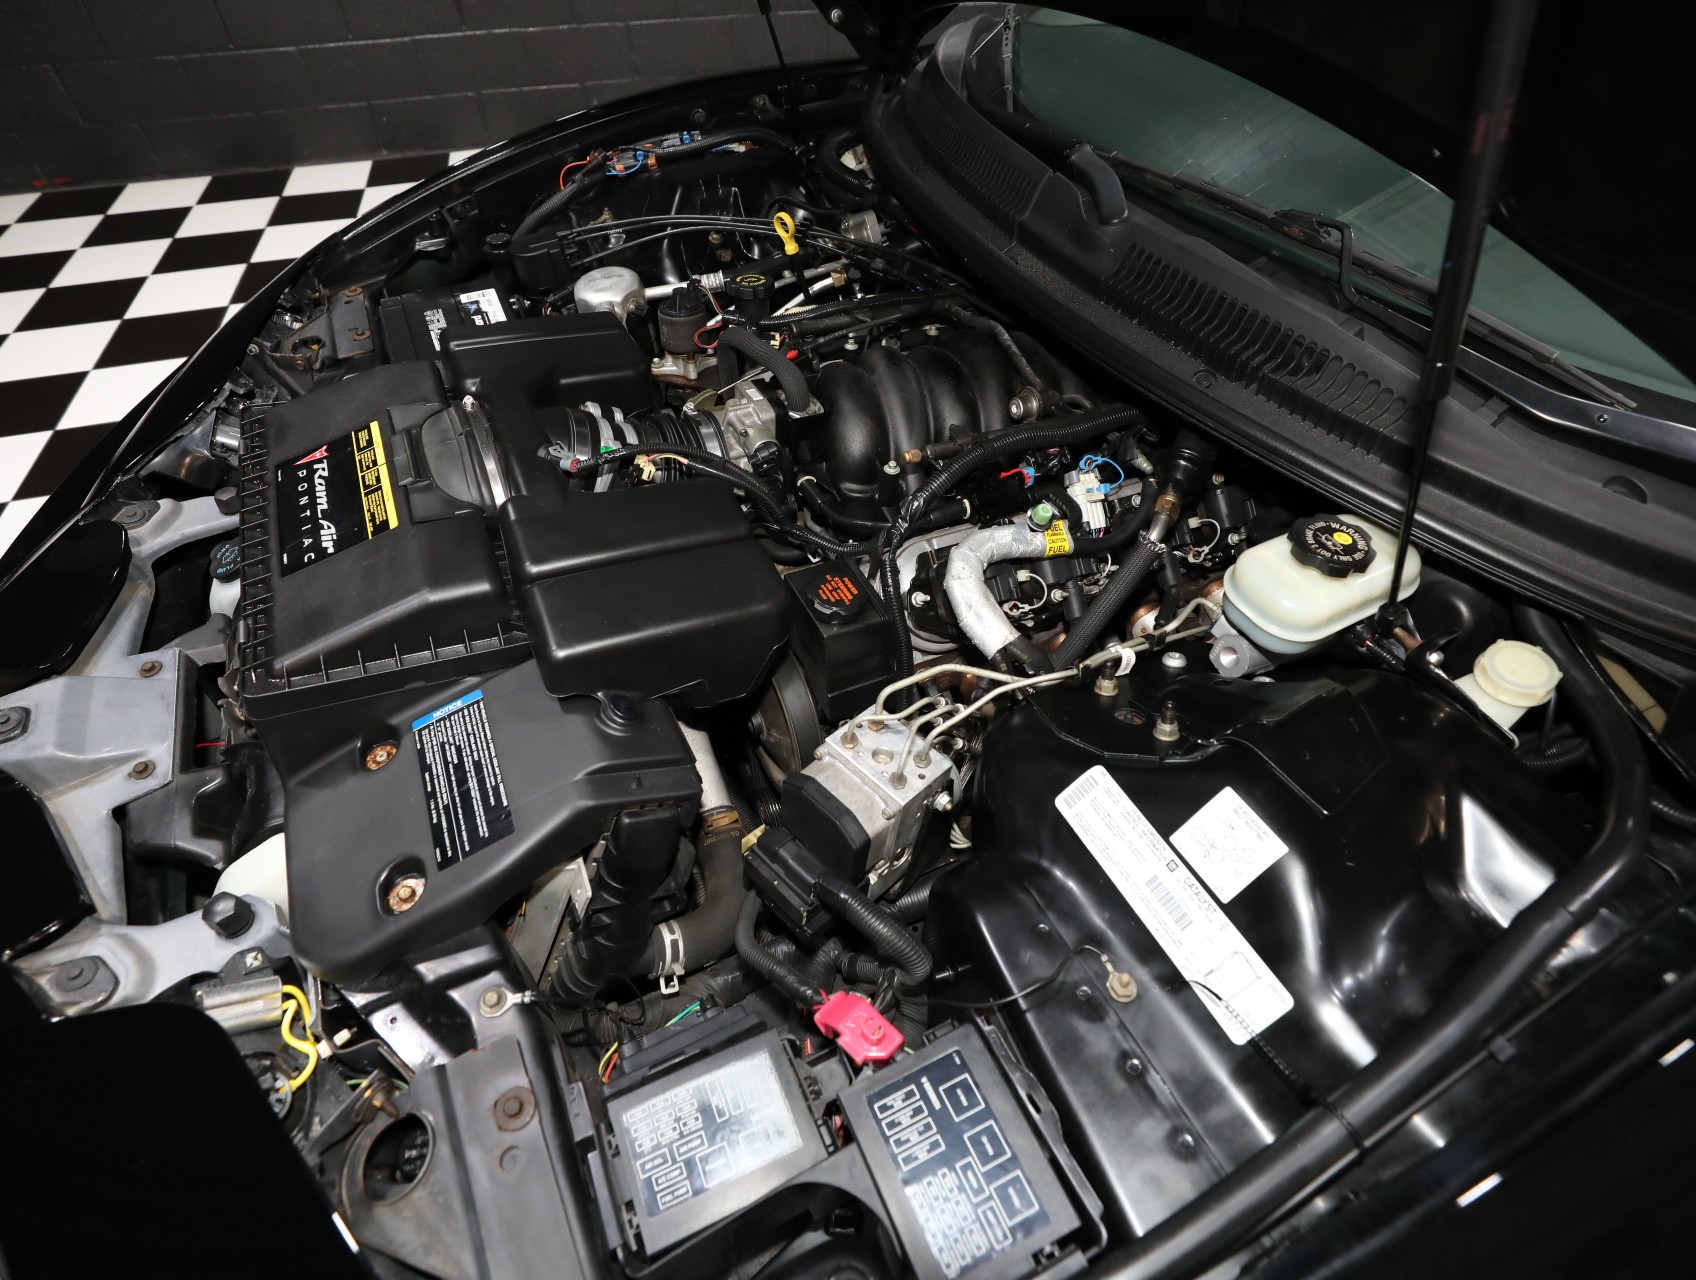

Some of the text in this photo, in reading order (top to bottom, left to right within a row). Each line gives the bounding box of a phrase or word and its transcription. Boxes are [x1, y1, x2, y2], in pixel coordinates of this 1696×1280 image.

[297, 469, 315, 563] PONTIAC
[313, 459, 337, 554] Ram Air
[1308, 521, 1327, 531] FLUID
[1330, 521, 1368, 551] WARNING
[1048, 545, 1067, 554] FUEL
[1317, 548, 1332, 558] DOT
[833, 577, 853, 600] STEERING
[842, 577, 858, 595] POWER
[432, 699, 463, 719] NOTICE
[1184, 877, 1217, 914] CATALYST
